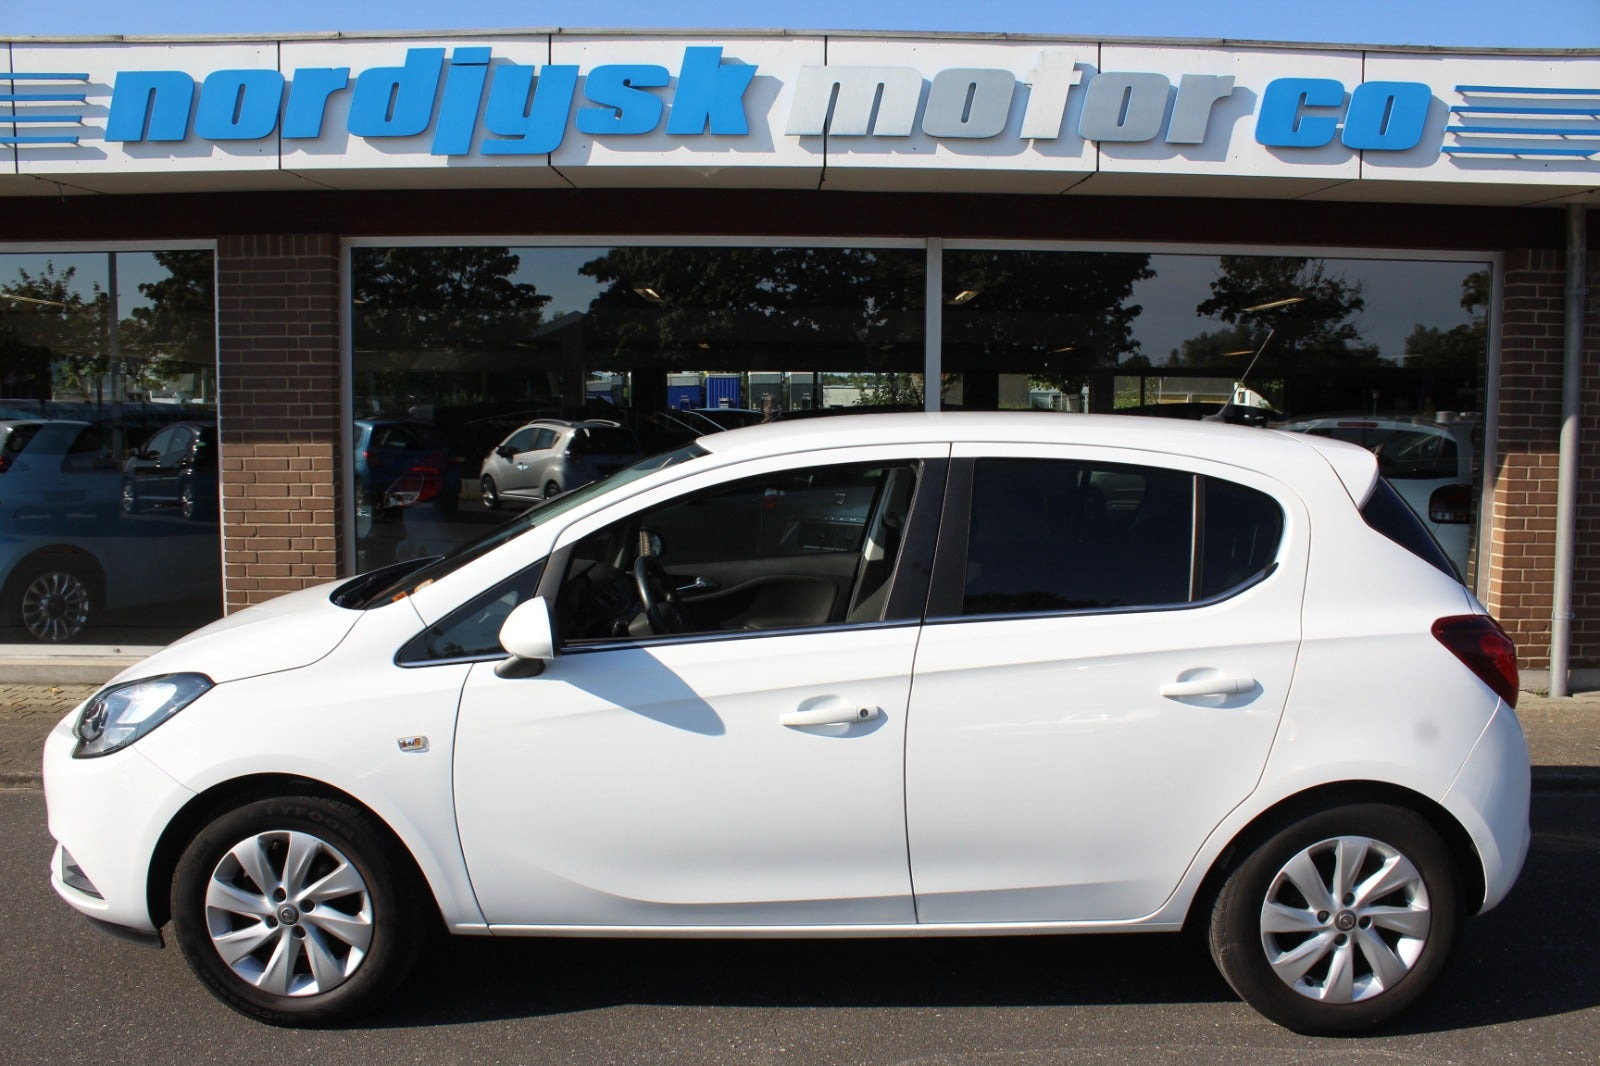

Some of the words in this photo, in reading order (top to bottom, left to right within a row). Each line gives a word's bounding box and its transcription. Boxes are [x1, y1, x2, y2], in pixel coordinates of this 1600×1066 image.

[105, 47, 758, 156] nordjysk
[784, 51, 1236, 145] motor
[1256, 77, 1433, 152] co
